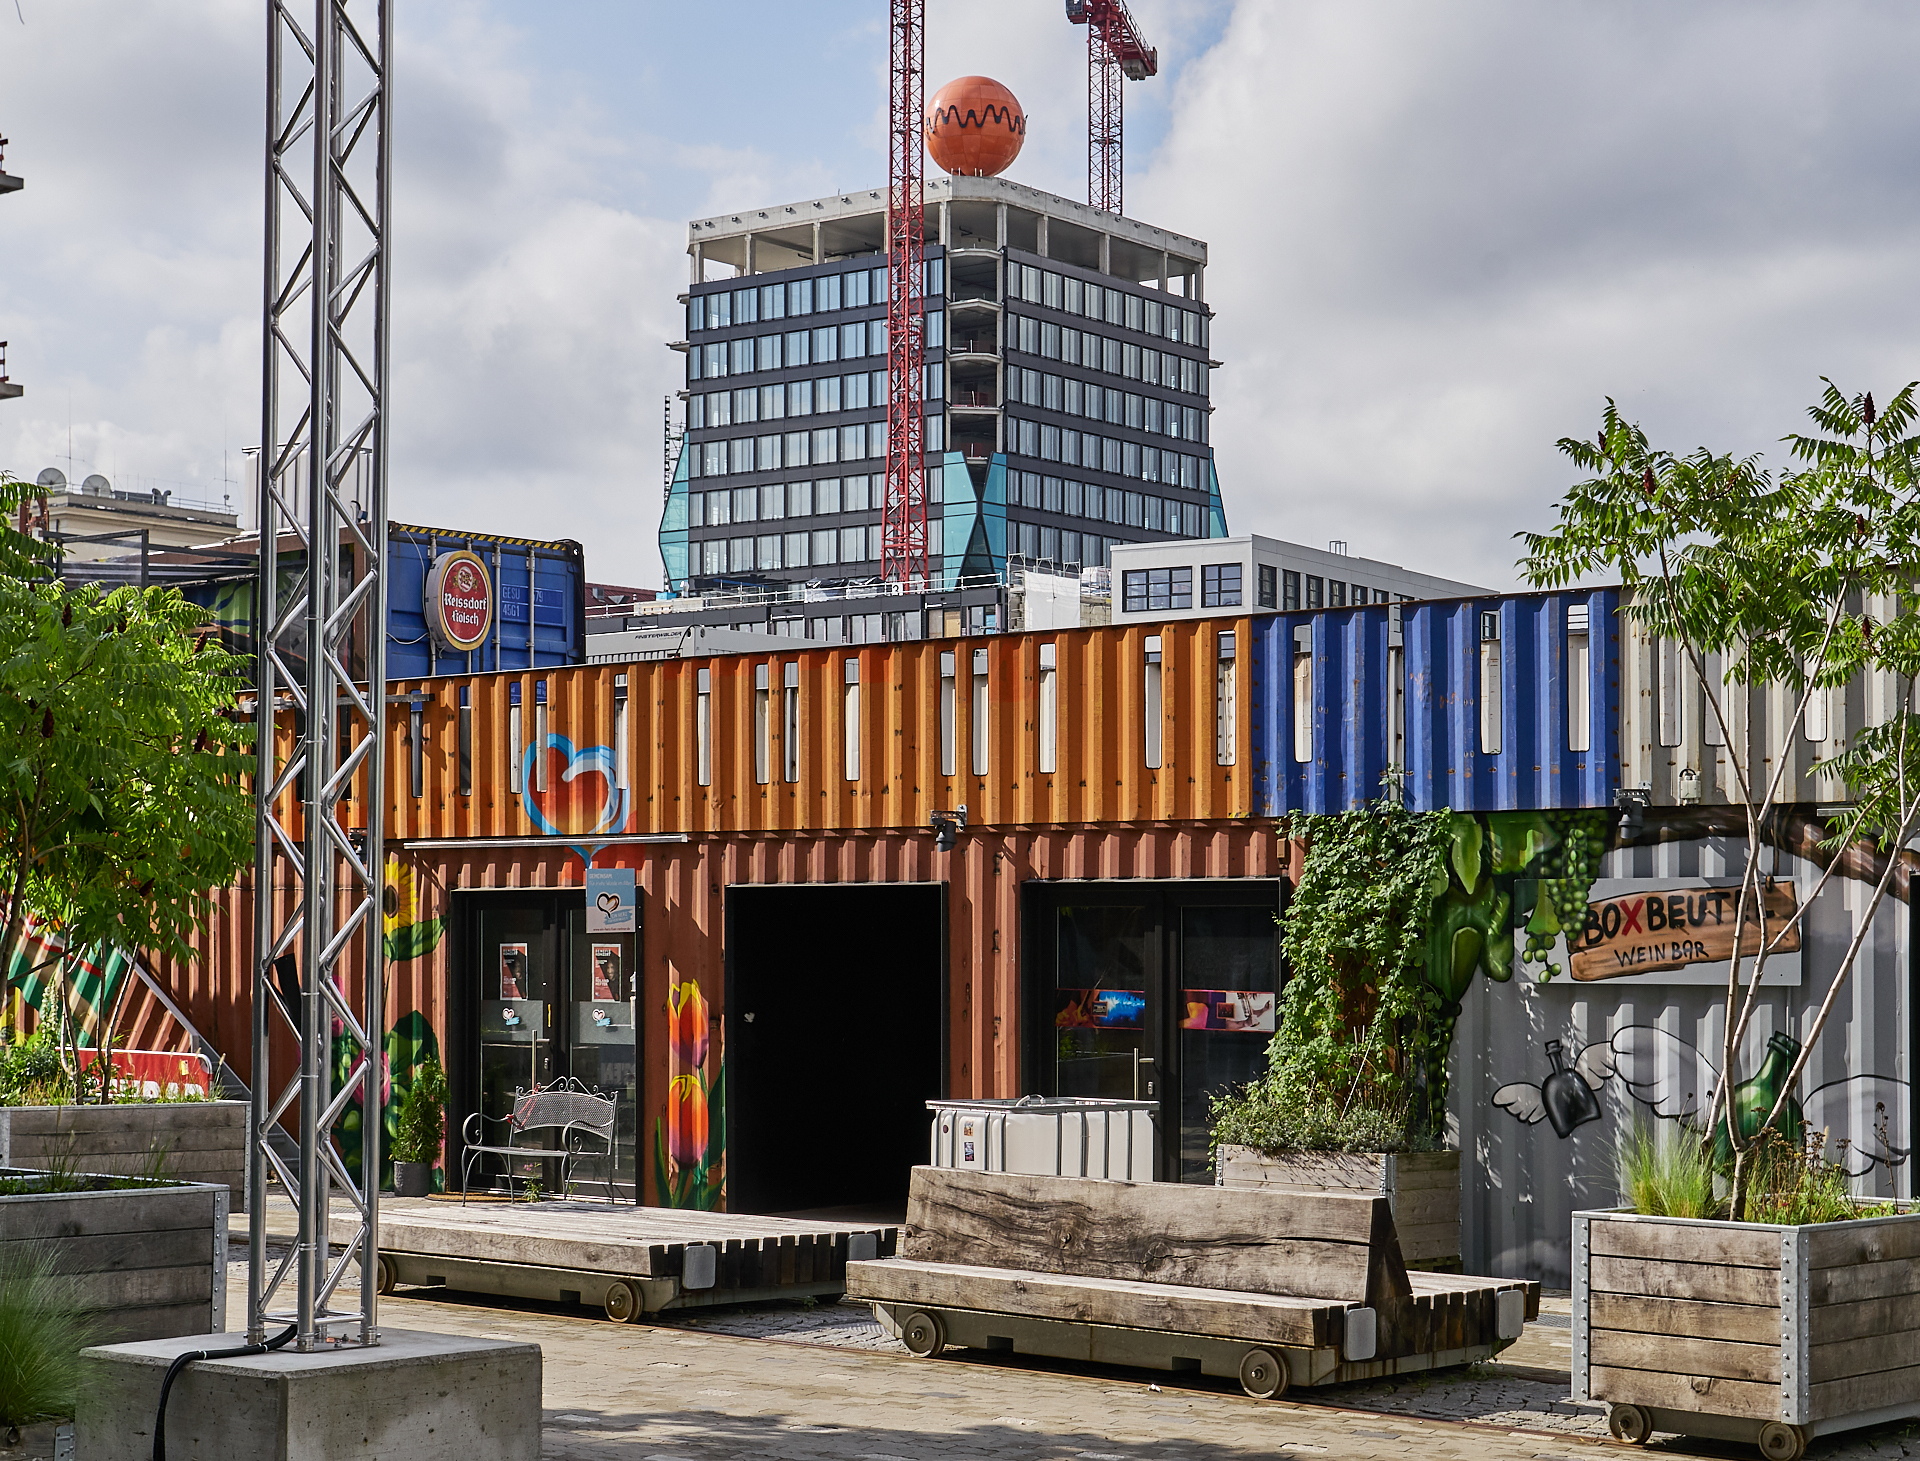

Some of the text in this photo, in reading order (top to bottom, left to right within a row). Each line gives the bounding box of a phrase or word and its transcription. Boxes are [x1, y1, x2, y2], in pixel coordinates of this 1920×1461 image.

[502, 586, 520, 600] GESU
[444, 593, 486, 610] Reissdorf
[502, 603, 520, 617] 45G1
[1614, 939, 1710, 967] WEIN BAR
